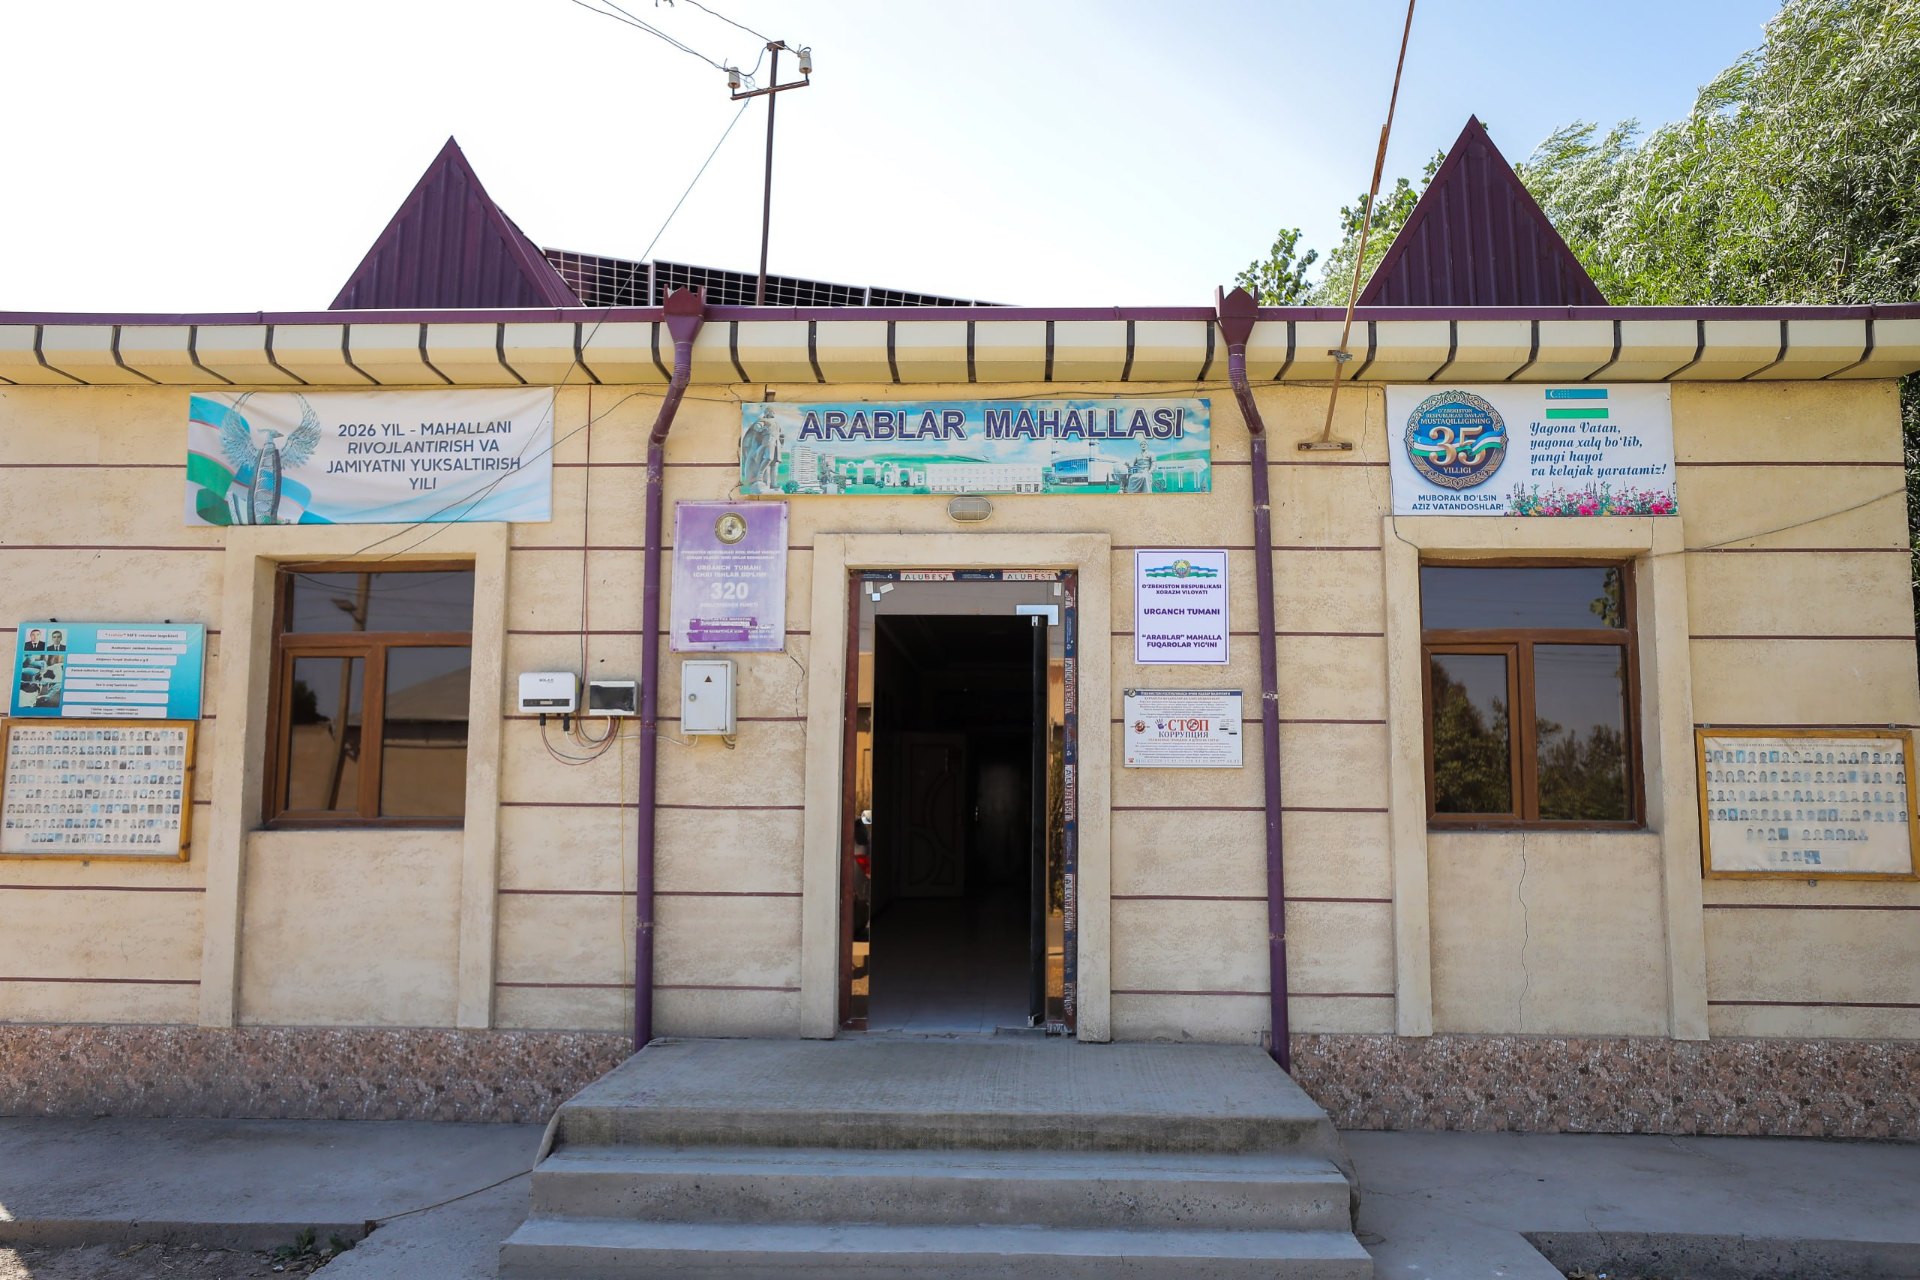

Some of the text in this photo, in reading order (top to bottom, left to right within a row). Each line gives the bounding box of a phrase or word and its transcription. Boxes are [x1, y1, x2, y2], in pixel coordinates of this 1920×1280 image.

[338, 423, 377, 438] 2026
[381, 423, 405, 437] YIL
[421, 420, 512, 436] MAHALLANI
[796, 406, 1186, 441] ARABLAR MAHALLASI
[1420, 418, 1491, 426] MUSTAQILLIGINING
[1529, 421, 1621, 437] Yagona Vatan,
[347, 439, 500, 455] RIVOJLANTIRISH VA
[1428, 426, 1487, 466] 35
[1529, 437, 1574, 451] yagona
[1575, 436, 1602, 451] xalq
[1530, 450, 1603, 465] yangi hayot
[326, 457, 522, 474] JAMIYATNI YUKSALTIRISH
[1530, 463, 1668, 479] va kelajak yaratamiz!
[408, 476, 437, 491] YILI
[1418, 494, 1461, 502] MUBORAK
[1412, 503, 1504, 511] AZIZ VATANDOSHLAR!
[904, 573, 950, 581] ALUBEST
[1007, 572, 1052, 580] ALUBEST
[710, 581, 749, 600] 320
[1146, 641, 1192, 649] FUQAROLAR
[1158, 731, 1209, 739] КОРРУПЦИЯ
